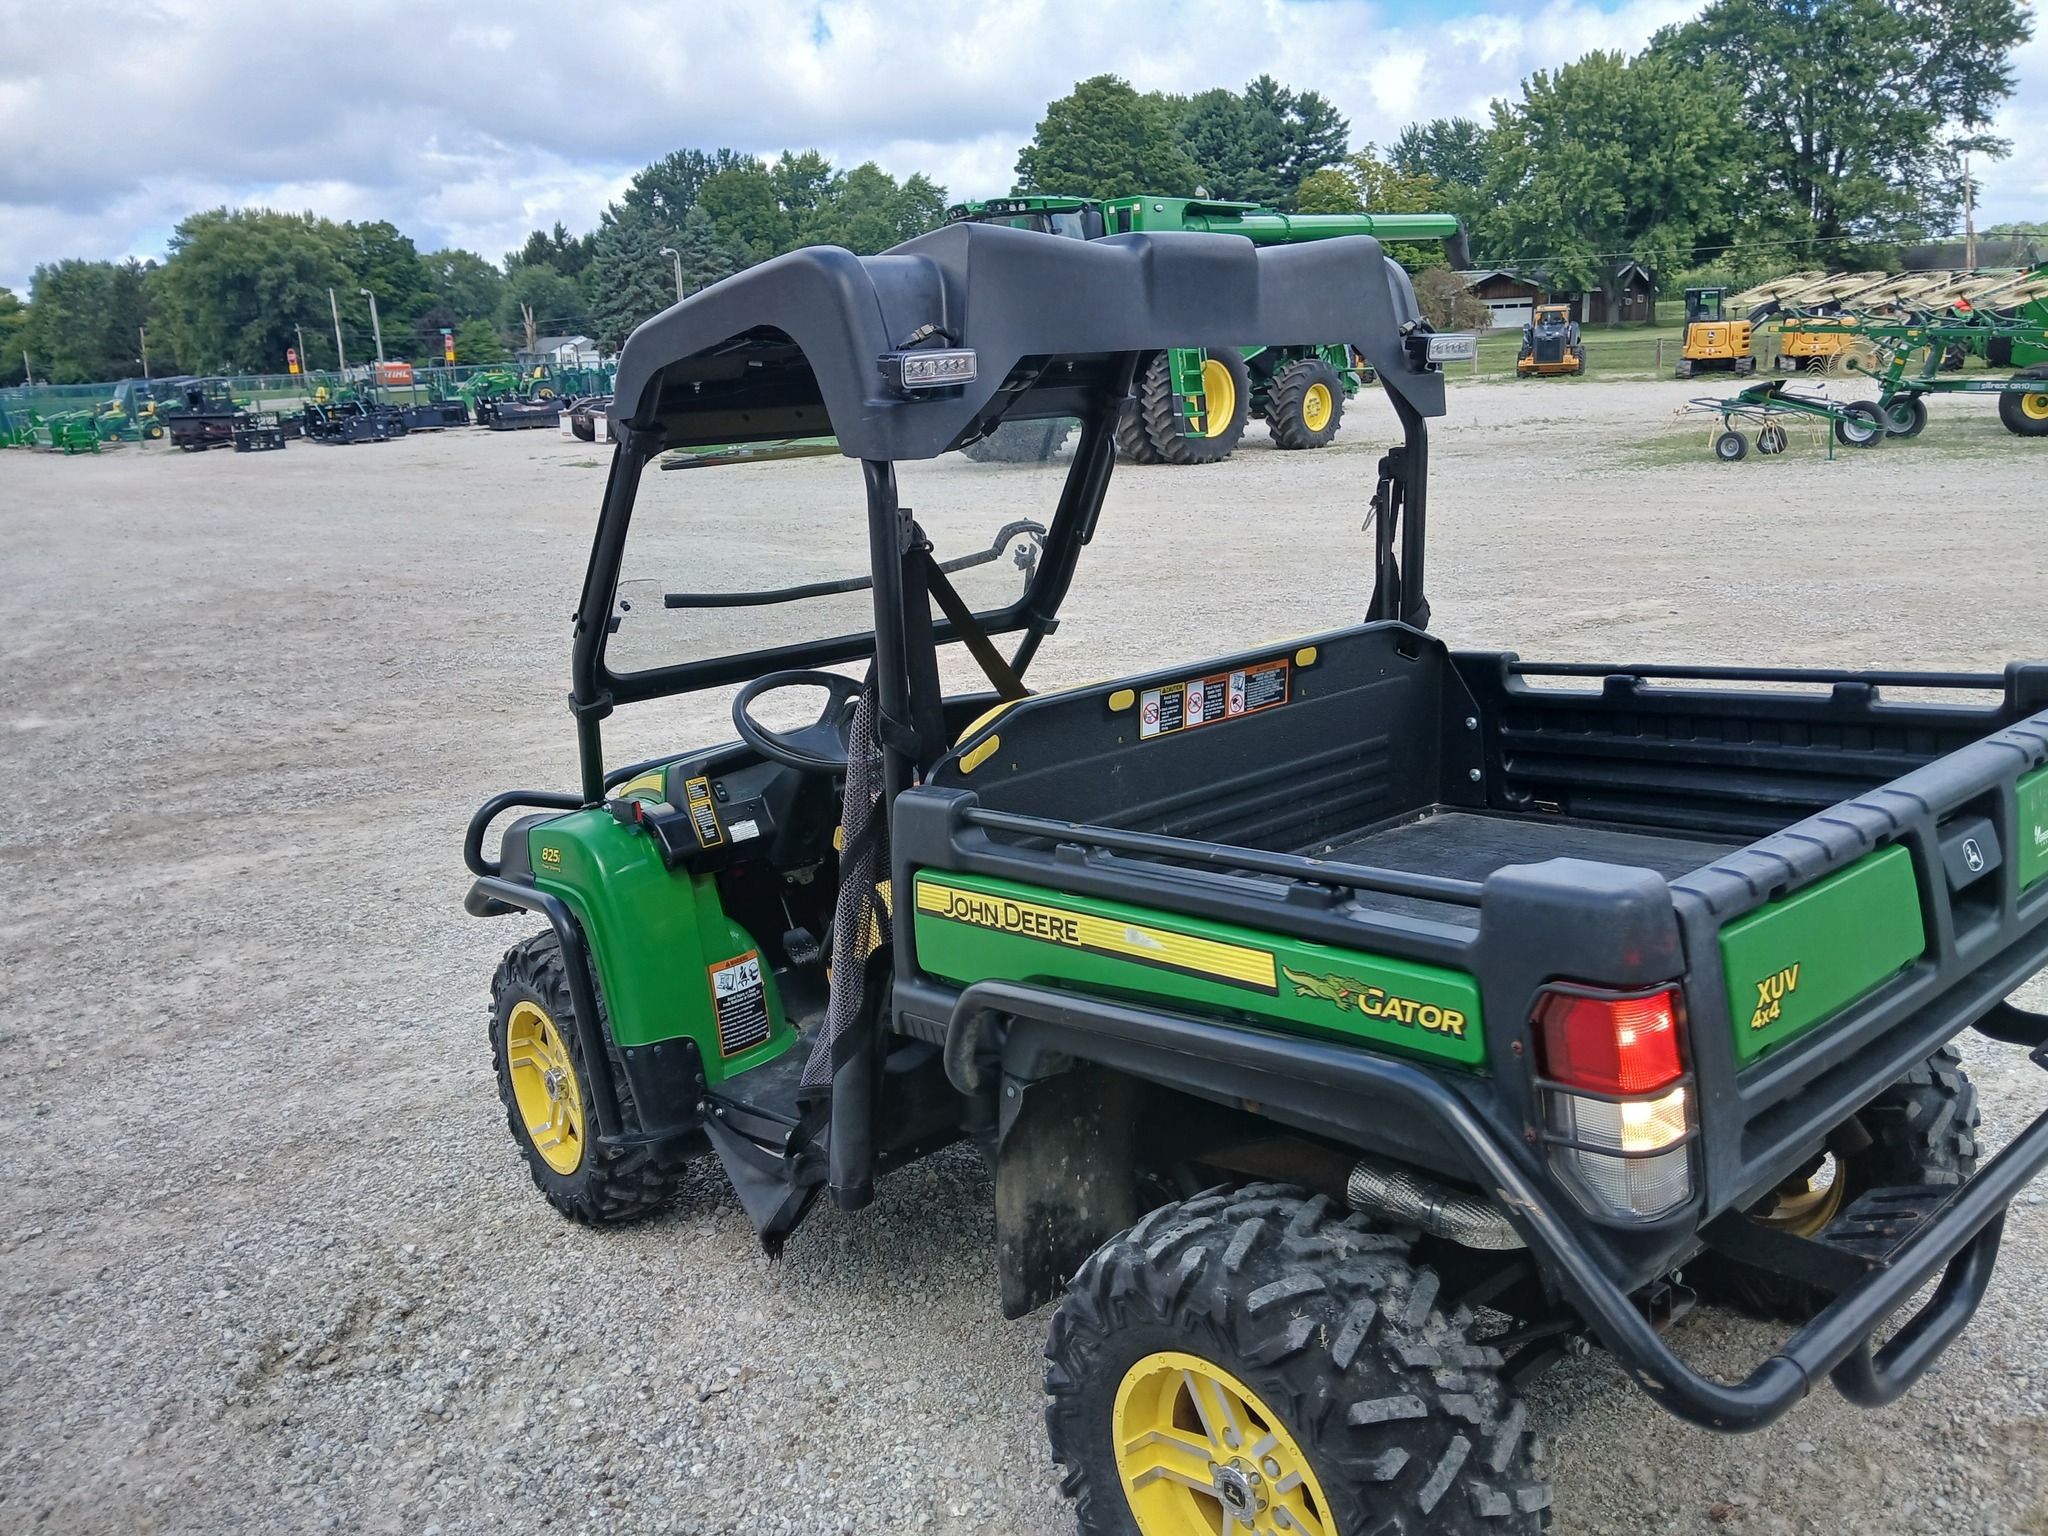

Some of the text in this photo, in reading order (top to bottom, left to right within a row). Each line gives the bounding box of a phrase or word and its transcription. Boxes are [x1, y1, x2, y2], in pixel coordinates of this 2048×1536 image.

[943, 891, 1080, 942] JOHN DEERE
[1756, 963, 1800, 1009] XUV
[1358, 987, 1466, 1037] GATOR
[1750, 999, 1781, 1029] 4x4
